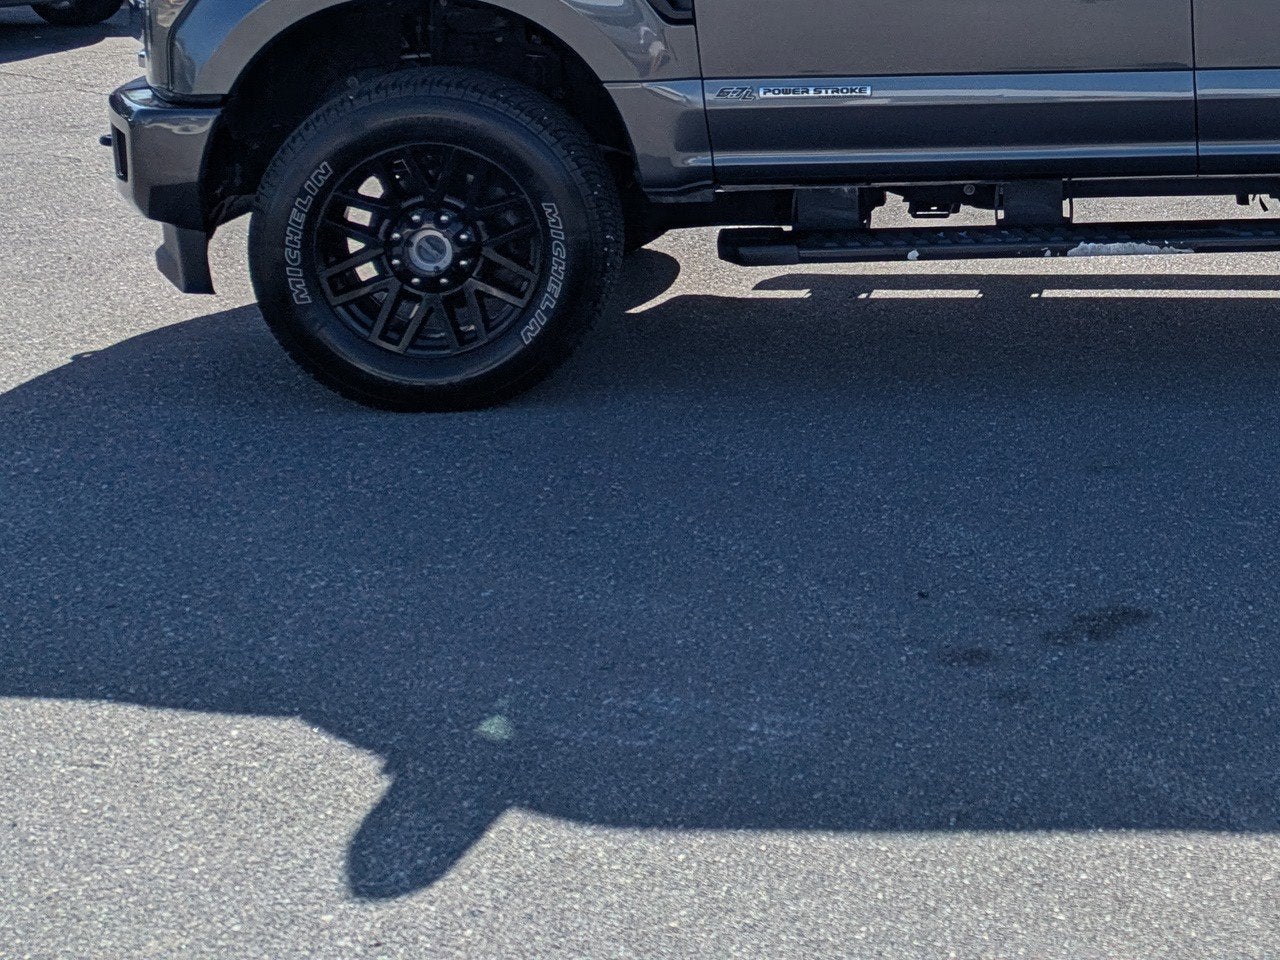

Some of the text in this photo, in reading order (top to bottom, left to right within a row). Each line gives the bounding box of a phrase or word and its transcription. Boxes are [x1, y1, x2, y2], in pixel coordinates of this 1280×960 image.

[762, 86, 811, 96] POWER
[813, 85, 868, 96] STROKE
[284, 160, 334, 306] MICHELIN
[520, 202, 567, 345] MICHELIN
